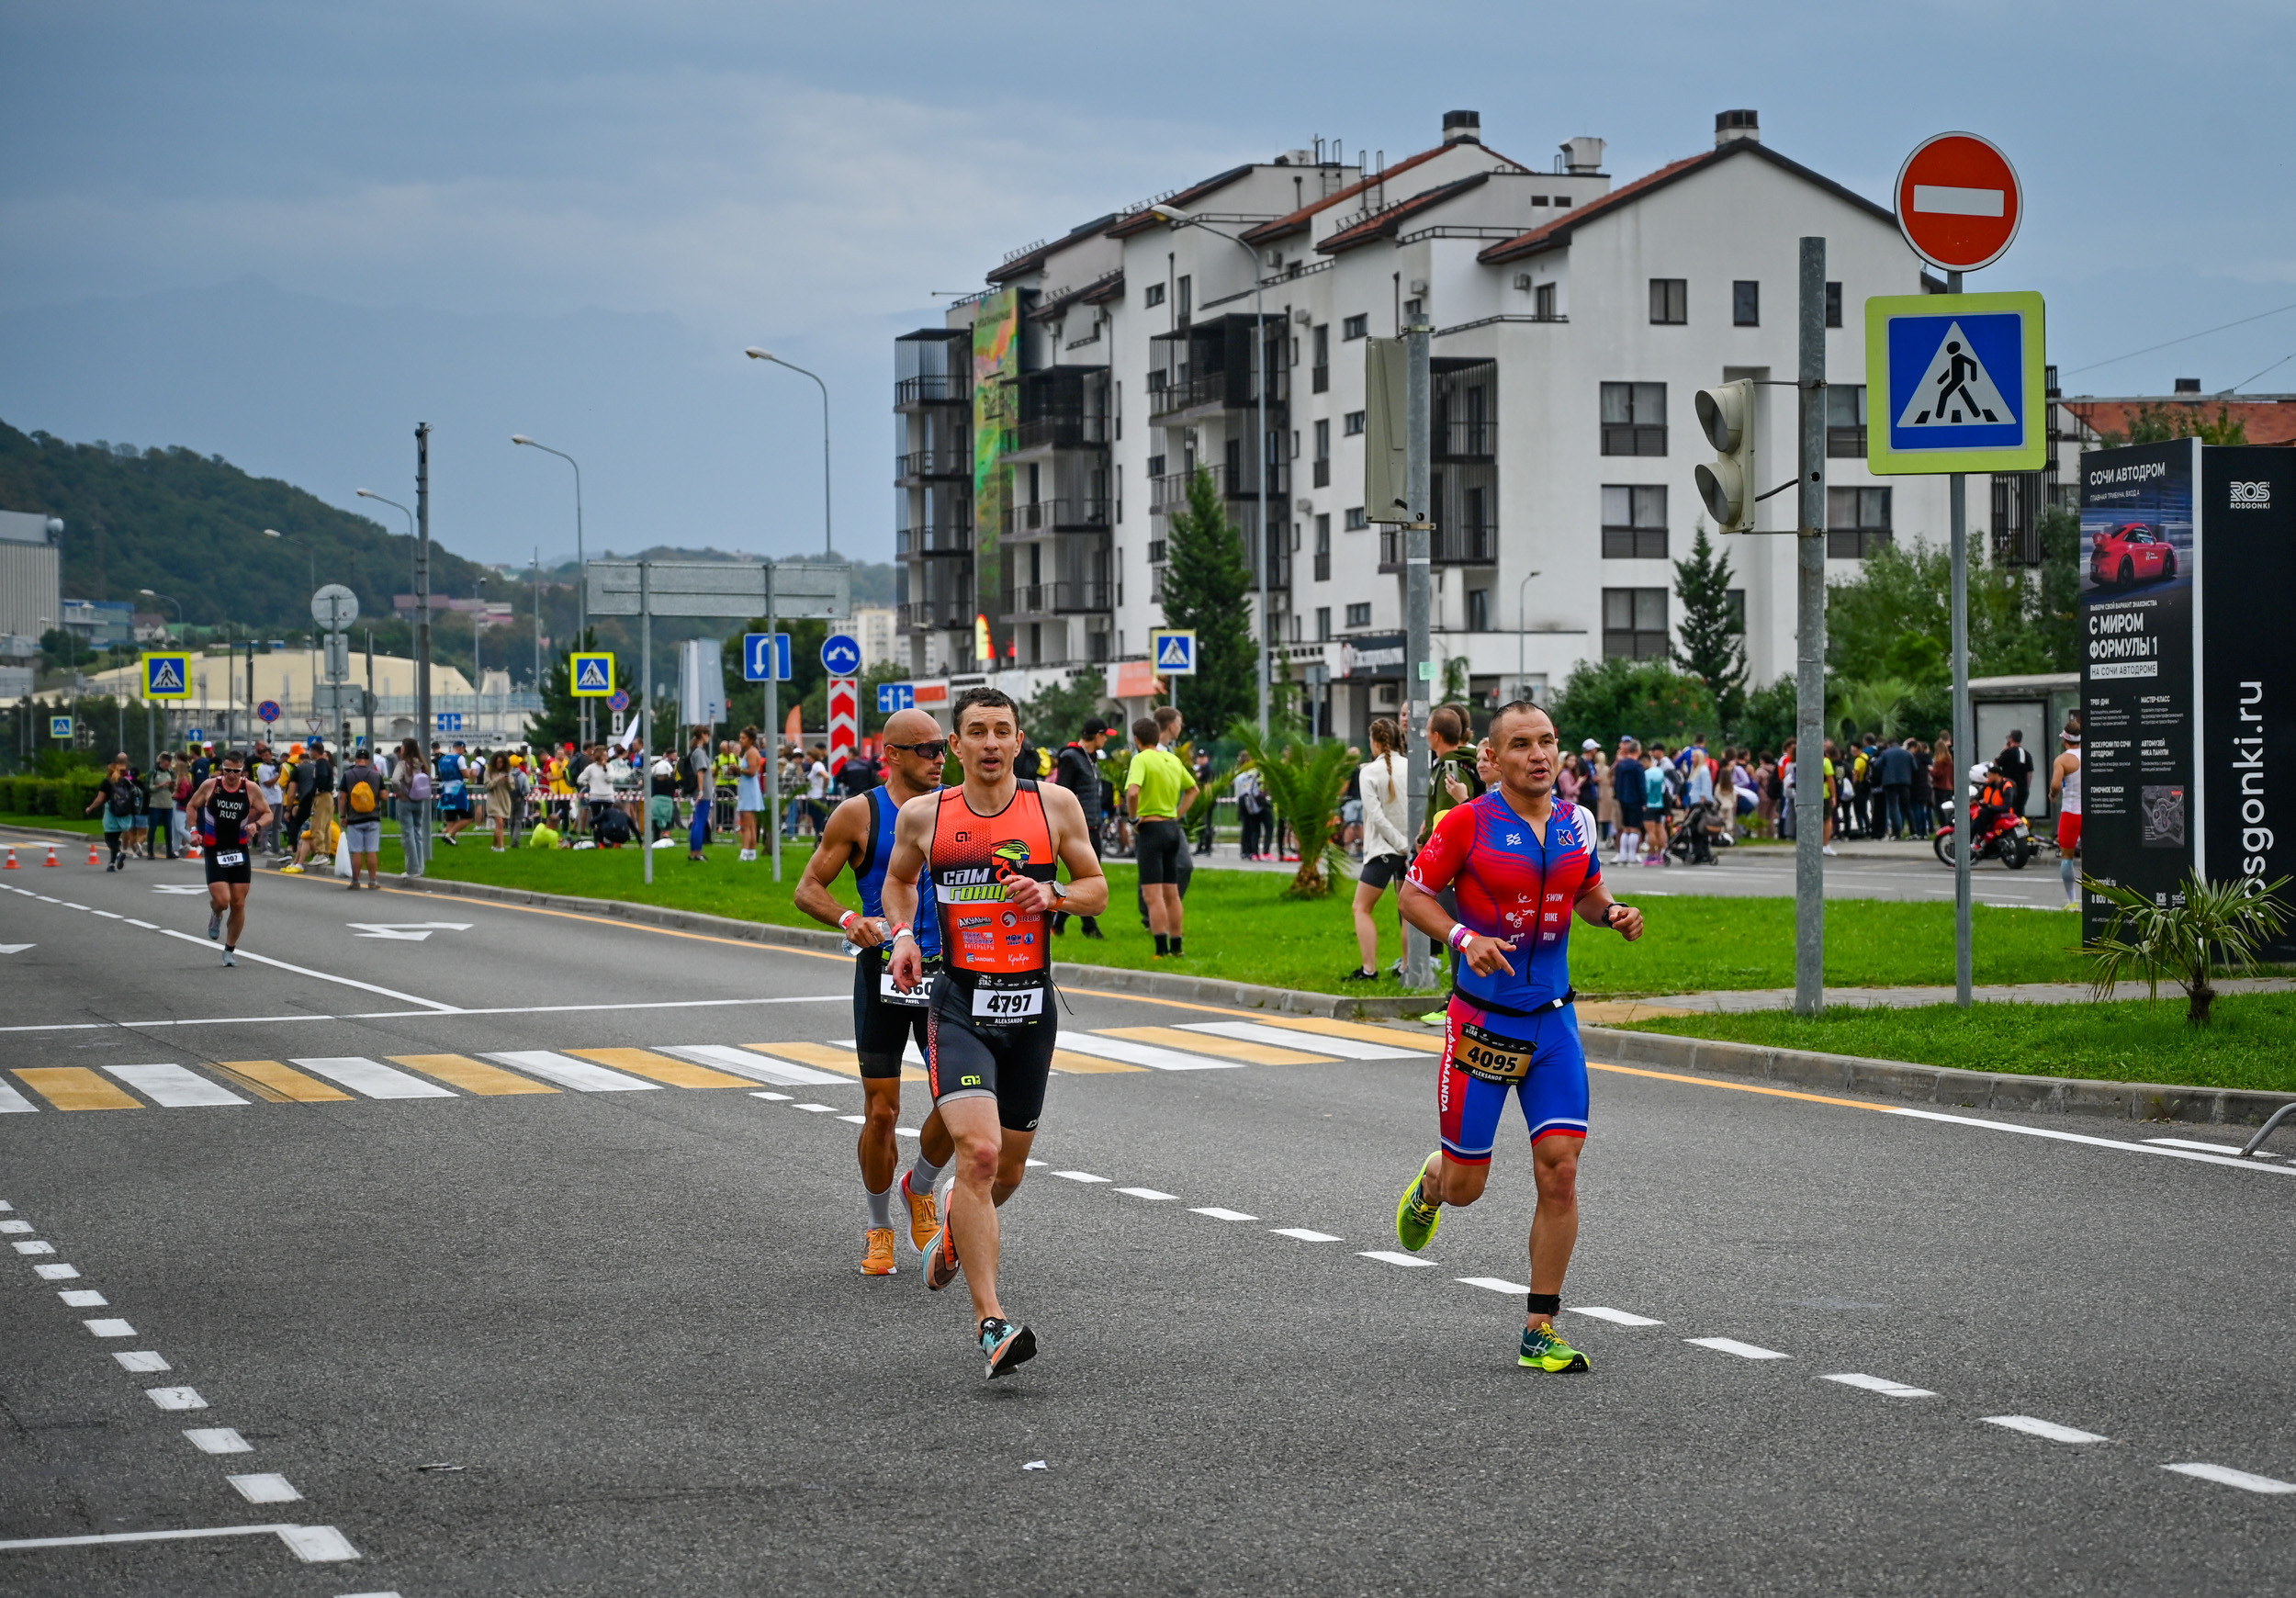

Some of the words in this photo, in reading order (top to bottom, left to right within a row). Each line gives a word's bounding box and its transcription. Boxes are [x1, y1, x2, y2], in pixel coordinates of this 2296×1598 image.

[2090, 468, 2114, 486] СОЧИ
[2116, 461, 2166, 482] АВТОДРОМ
[2230, 481, 2270, 502] ROS
[2089, 615, 2098, 635] С
[2100, 613, 2144, 634] МИРОМ
[2089, 636, 2149, 659] ФОРМУЛЫ
[2152, 636, 2157, 655] 1
[2092, 668, 2099, 676] НА
[2101, 666, 2118, 676] СОЧИ
[2120, 664, 2156, 675] АВТОДРОМЕ
[217, 798, 243, 811] VOLKOV
[2233, 681, 2275, 918] osgonki.ru
[219, 810, 237, 820] RUS
[222, 855, 238, 863] 4107
[1546, 893, 1564, 903] SWIM
[2091, 894, 2096, 904] 8
[1019, 914, 1041, 923] IRBIS
[1544, 912, 1559, 922] BIKE
[1542, 932, 1557, 941] RUN
[987, 994, 1032, 1013] 4797
[1468, 1046, 1518, 1073] 4095
[1471, 1068, 1503, 1082] ALEKSANDR
